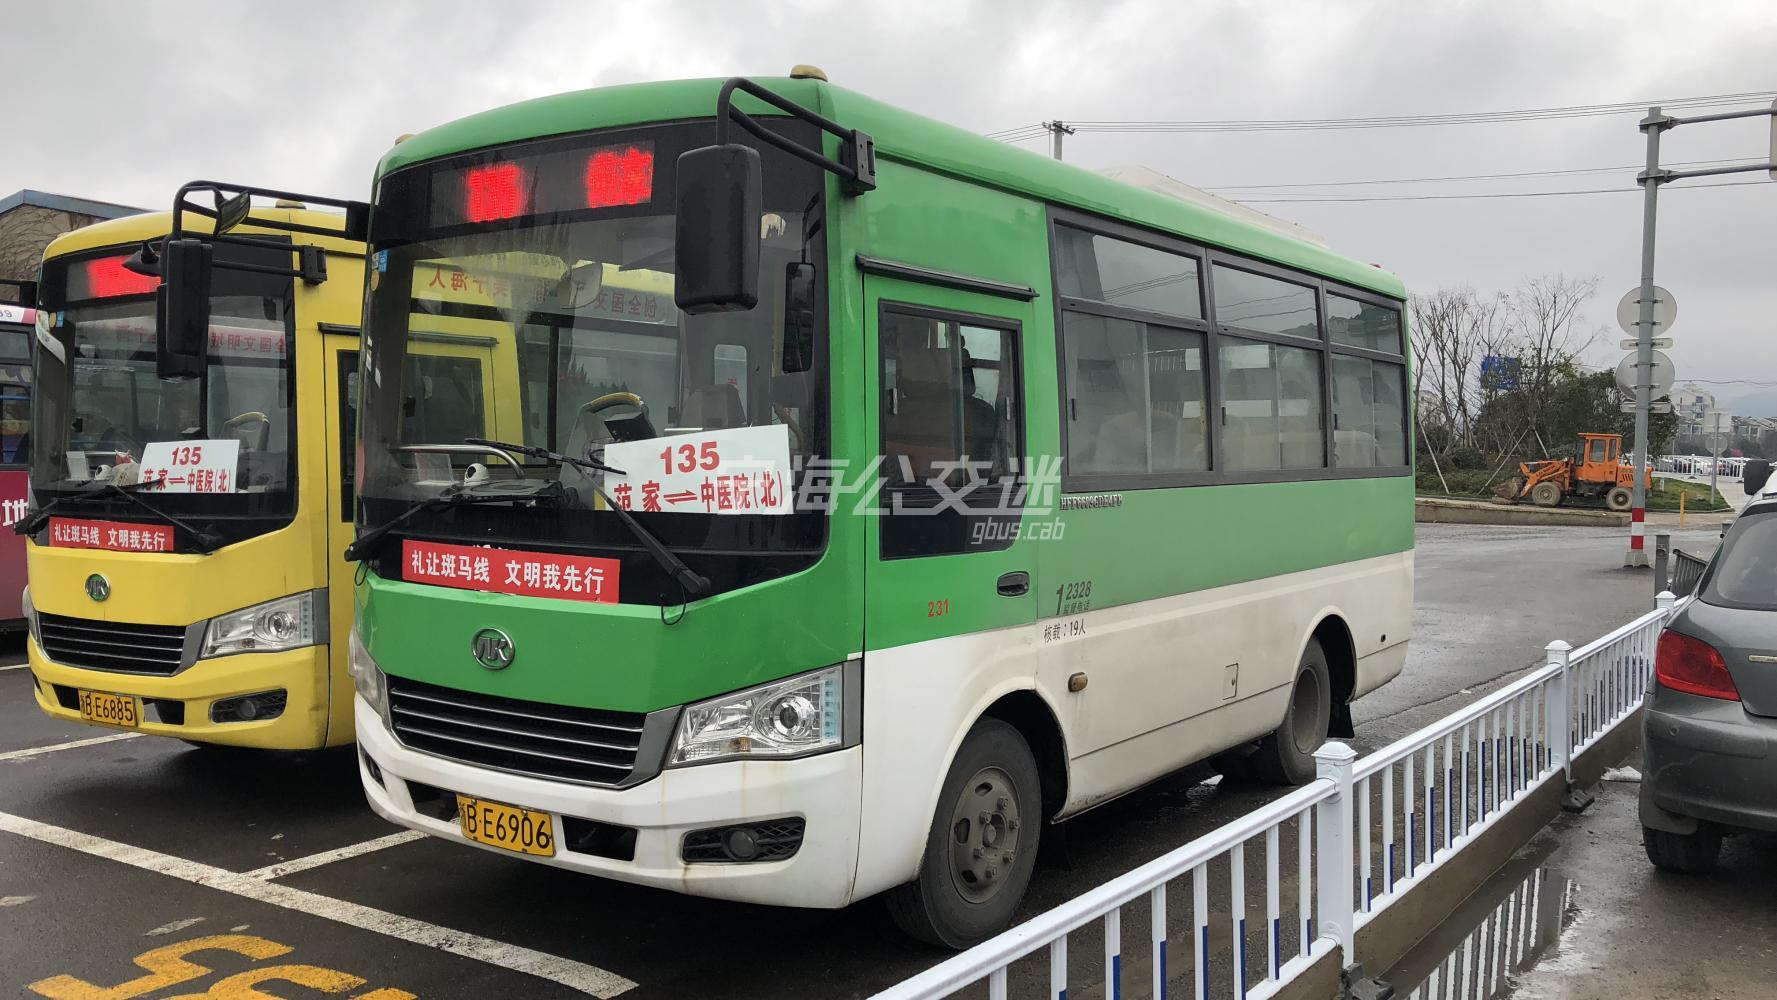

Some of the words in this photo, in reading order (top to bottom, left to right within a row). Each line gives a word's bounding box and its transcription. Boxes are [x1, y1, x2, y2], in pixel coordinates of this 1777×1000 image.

[172, 447, 202, 466] 135
[660, 441, 720, 475] 135
[54, 524, 100, 546] 礼让斑马线
[107, 528, 166, 551] 文明我先行
[411, 550, 490, 583] 礼让斑马线
[504, 560, 604, 595] 文明我先行
[927, 598, 950, 618] 231
